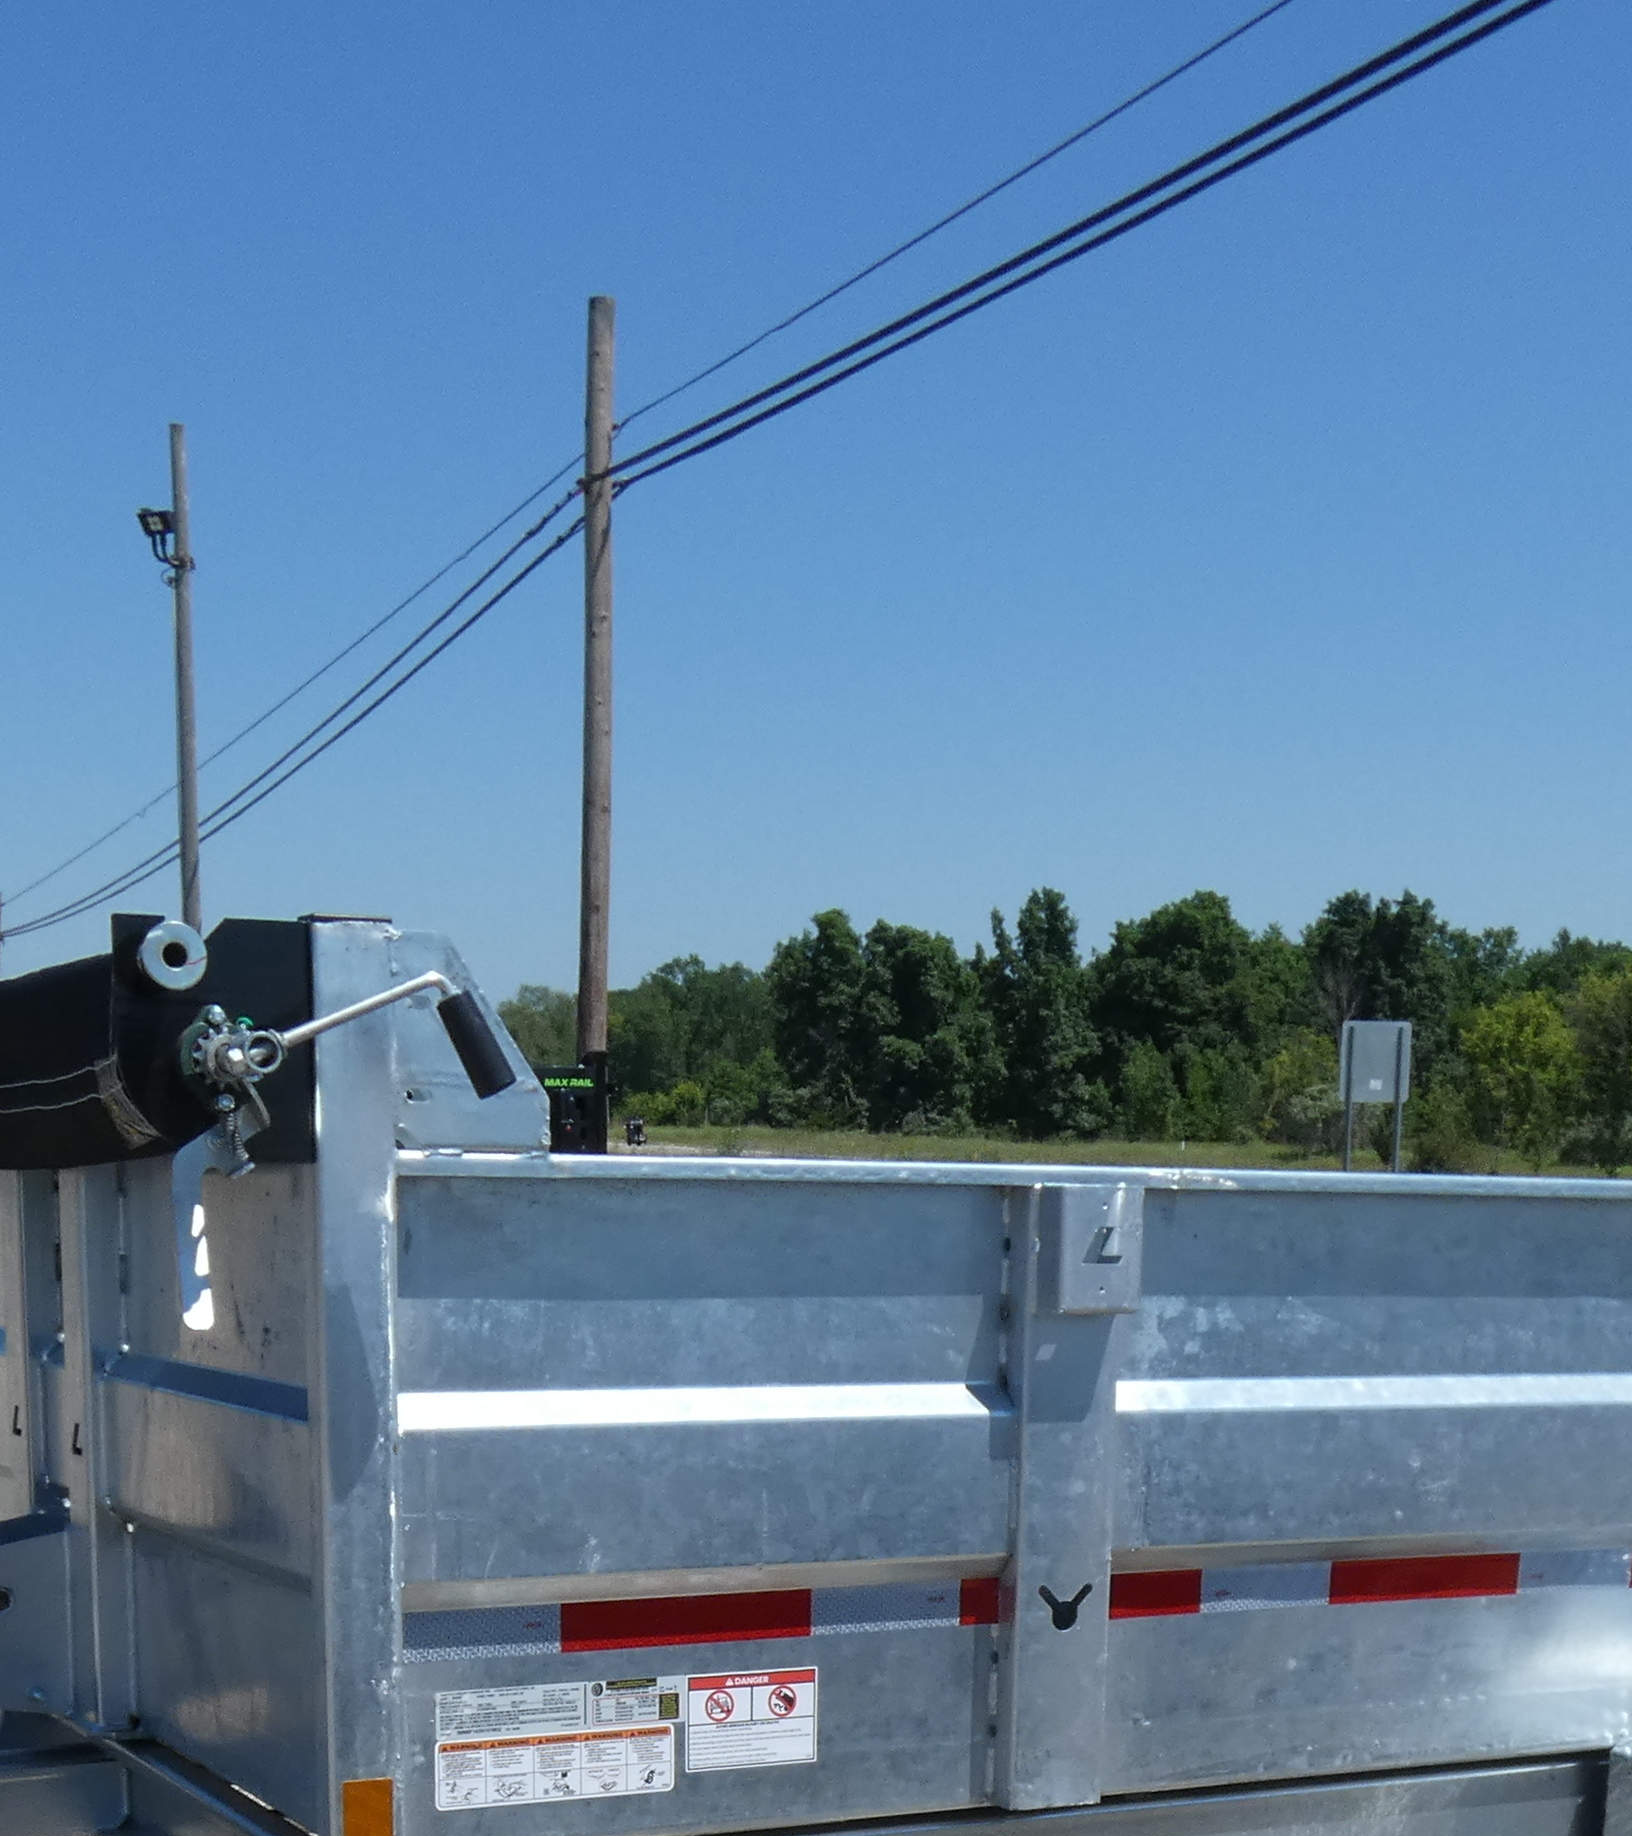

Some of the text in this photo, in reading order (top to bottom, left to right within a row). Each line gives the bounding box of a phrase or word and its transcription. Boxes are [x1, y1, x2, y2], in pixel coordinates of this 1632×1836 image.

[544, 1078, 594, 1087] MAX RAIL
[734, 1676, 769, 1686] DANGER
